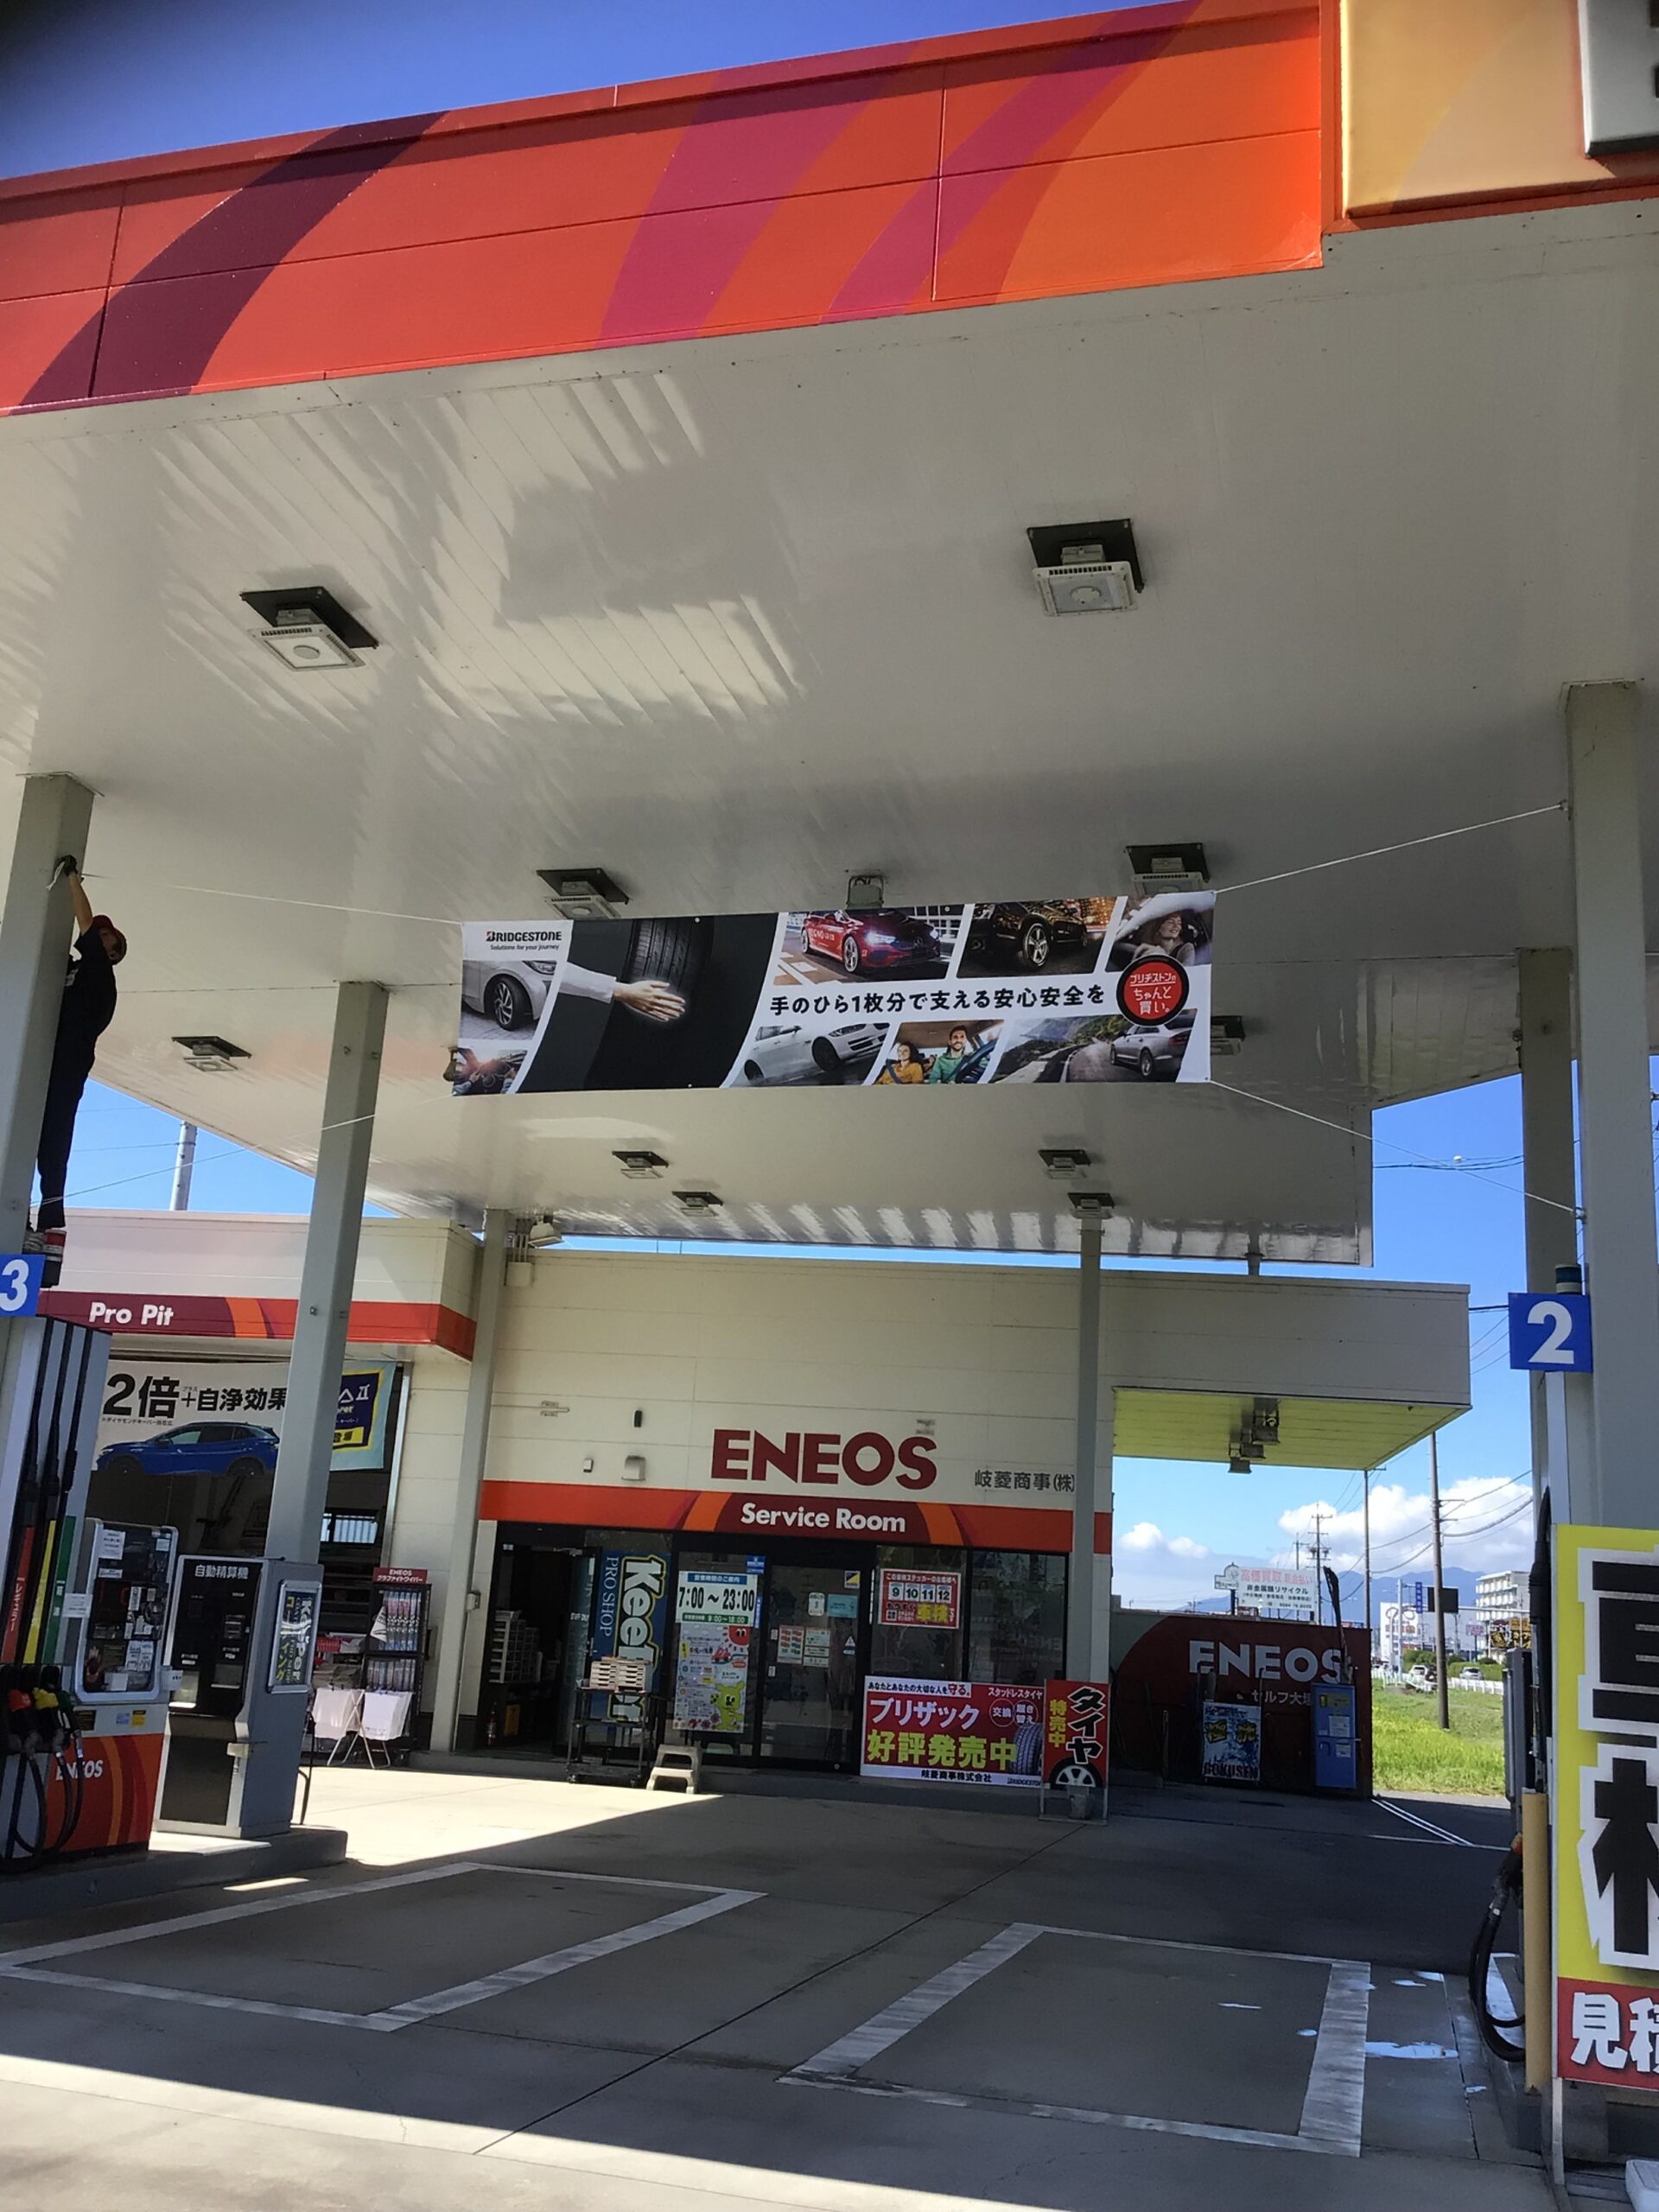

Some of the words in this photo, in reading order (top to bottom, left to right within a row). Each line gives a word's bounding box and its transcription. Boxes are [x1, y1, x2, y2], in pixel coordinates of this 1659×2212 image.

[485, 931, 562, 942] BRIDGESTONE
[770, 983, 1105, 1016] 手のひら1枚分で支える安心安全を
[1133, 986, 1172, 1001] ちゃんと
[0, 1259, 29, 1312] 3
[89, 1301, 132, 1324] Pro
[141, 1304, 174, 1325] Pit
[1527, 1300, 1574, 1364] 2
[103, 1373, 180, 1419] 2倍
[710, 1428, 938, 1490] ENEOS
[741, 1502, 830, 1529] Service
[836, 1508, 906, 1532] Room
[194, 1564, 249, 1580] 自動精算機
[604, 1556, 619, 1589] PRO
[678, 1586, 704, 1609] 7:00
[722, 1588, 755, 1611] 23:00
[892, 1587, 899, 1597] 9
[906, 1588, 918, 1599] 10
[922, 1590, 933, 1600] 11
[938, 1591, 950, 1601] 12
[600, 1592, 615, 1637] SHOP
[1189, 1640, 1342, 1684] ENEOS
[988, 1687, 1043, 1700] スタッドレスタイヤ
[870, 1696, 981, 1731] ブリザック
[993, 1706, 1012, 1719] 交換
[1048, 1699, 1067, 1748] 特売中
[1067, 1686, 1107, 1764] タイヤ
[867, 1729, 1018, 1771] 好評発売中
[921, 1769, 993, 1783] 岐菱商事株式会社
